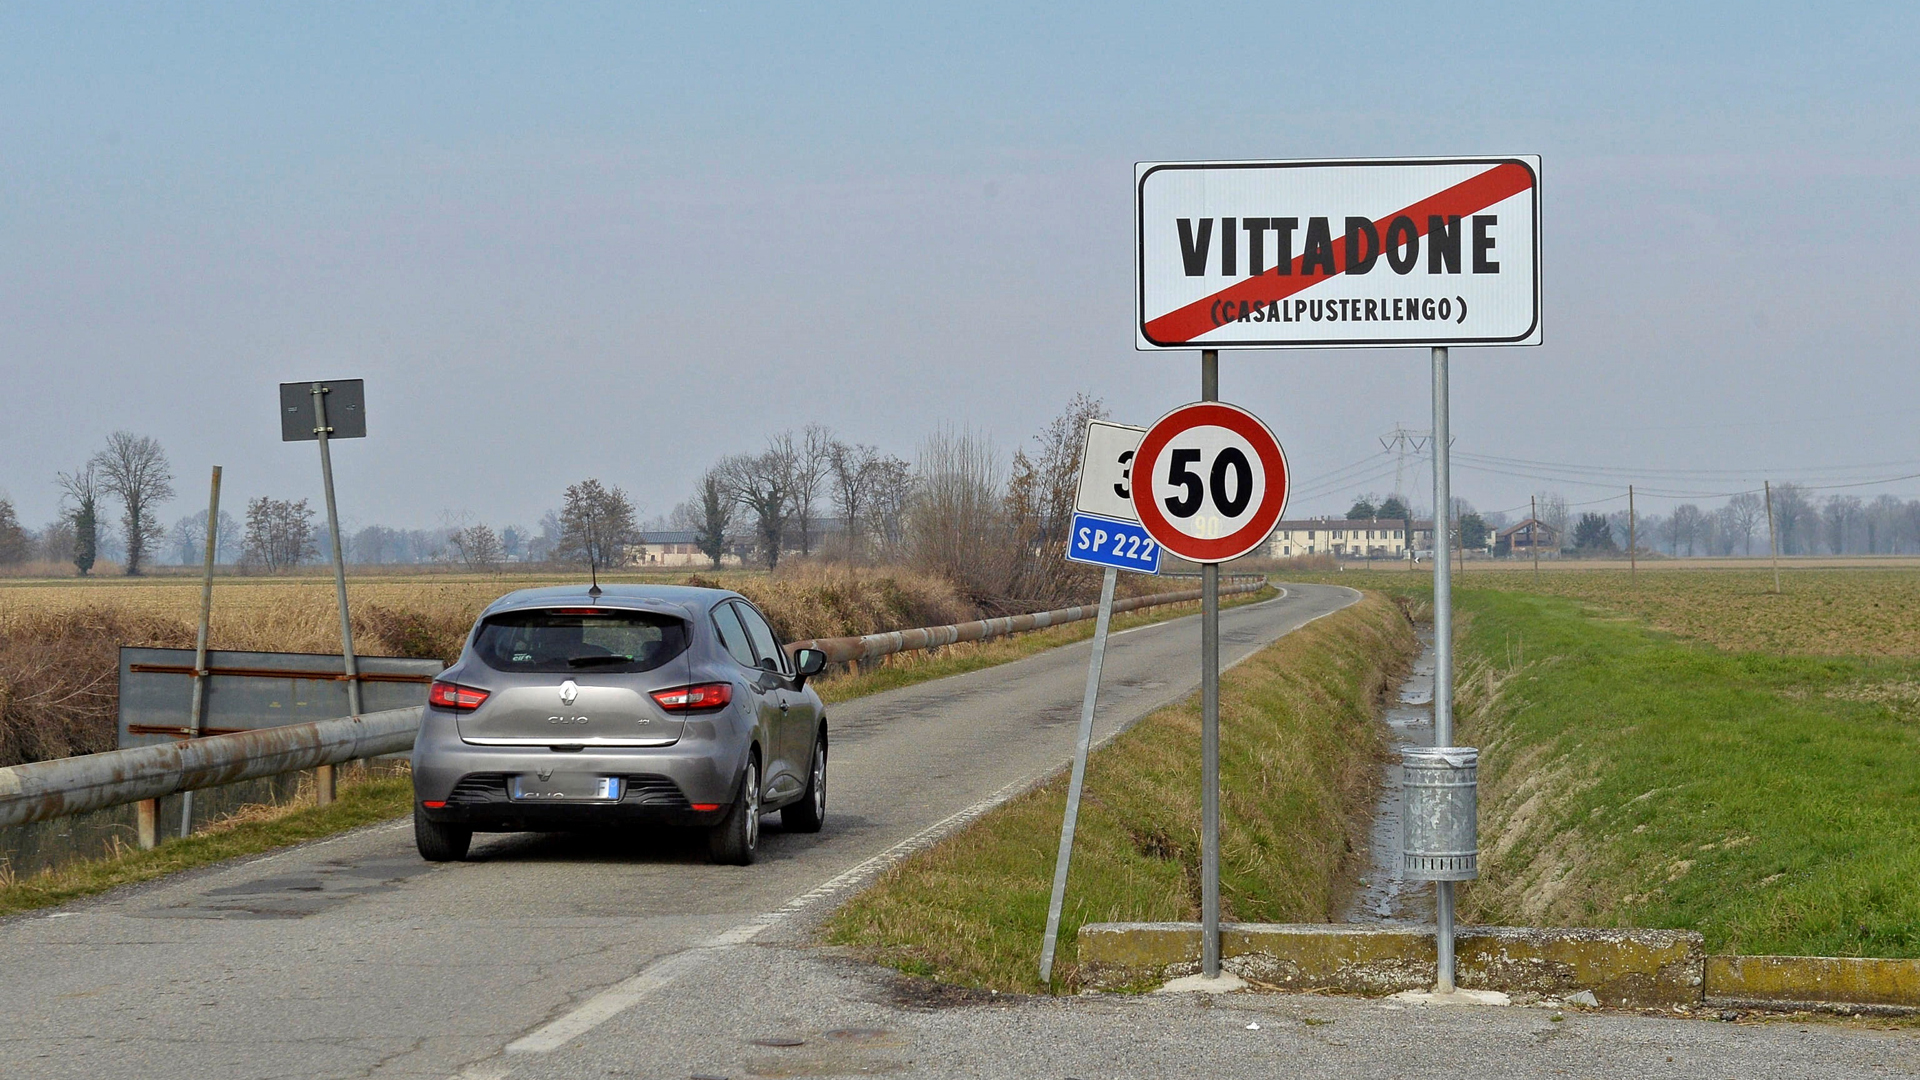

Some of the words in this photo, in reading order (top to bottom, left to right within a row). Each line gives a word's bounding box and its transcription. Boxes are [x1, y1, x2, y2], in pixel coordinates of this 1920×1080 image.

[1175, 214, 1501, 277] VITTADONE
[1210, 295, 1468, 327] (CASALPUSTERLENGO)
[1163, 446, 1254, 519] 50
[1077, 526, 1108, 553] SP
[1112, 532, 1156, 562] 222
[547, 715, 589, 725] CLIO
